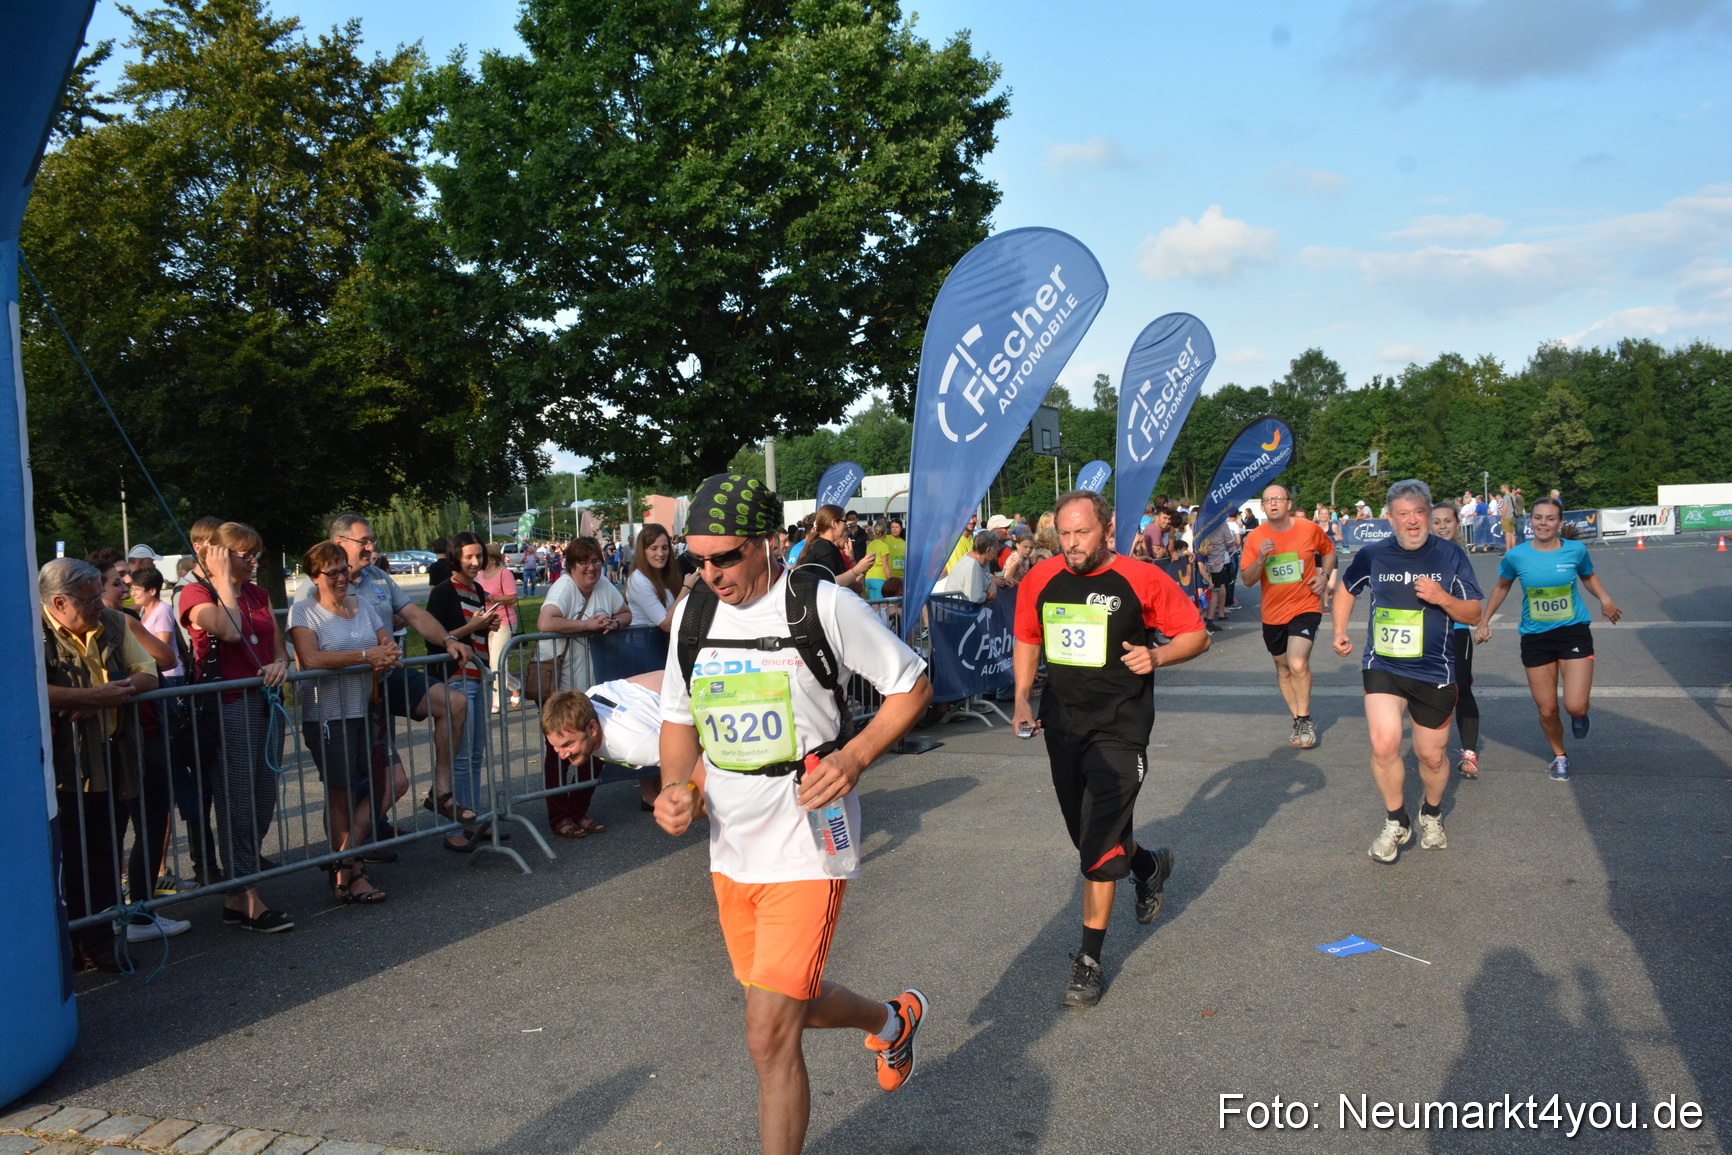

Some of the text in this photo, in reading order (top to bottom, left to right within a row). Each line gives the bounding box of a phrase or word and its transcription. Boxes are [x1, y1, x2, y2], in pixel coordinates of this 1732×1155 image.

[962, 263, 1067, 416] Fischer
[998, 293, 1079, 415] AUTOMOBILE
[1140, 336, 1195, 443] Fischer
[827, 469, 854, 504] Fischer
[1088, 466, 1104, 491] scher
[1210, 452, 1270, 504] Frischmann
[1360, 529, 1392, 538] Fischer
[1272, 564, 1294, 577] 565
[1378, 573, 1403, 582] EURO
[1533, 598, 1568, 612] 1060
[1061, 628, 1086, 648] 33
[1381, 627, 1411, 644] 375
[705, 711, 782, 743] 1320
[828, 814, 850, 850] ACTIVE
